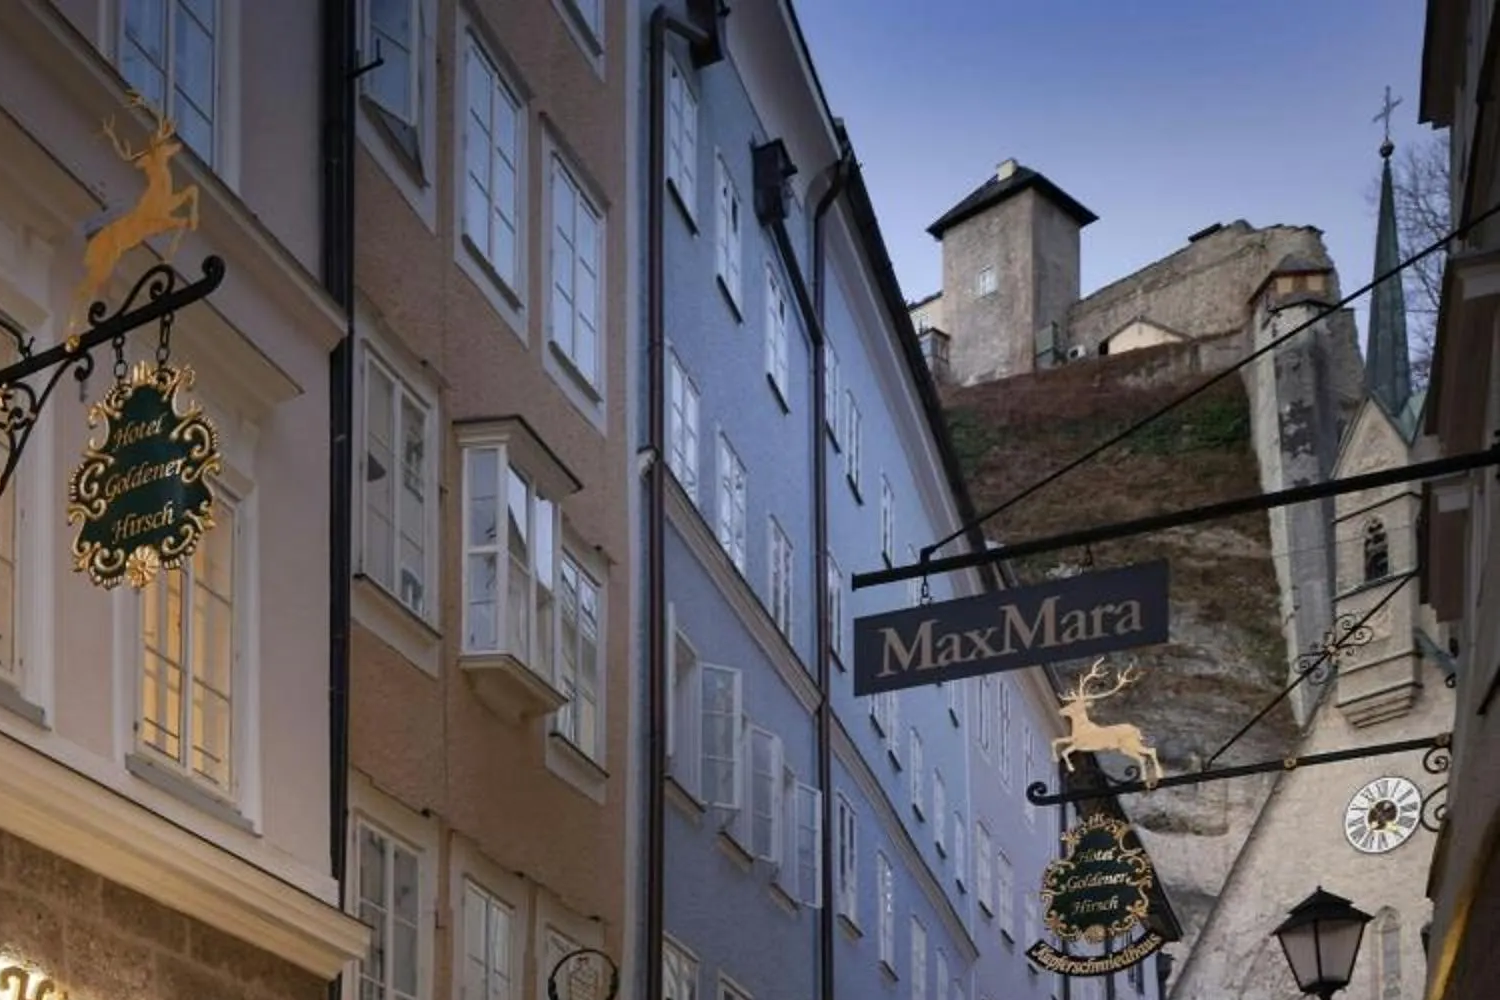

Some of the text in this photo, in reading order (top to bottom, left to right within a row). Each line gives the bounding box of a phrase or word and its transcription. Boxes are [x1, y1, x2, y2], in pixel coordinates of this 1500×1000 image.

[113, 412, 167, 448] Hotel
[105, 456, 186, 501] Goldener
[112, 500, 175, 544] Hirsch
[876, 596, 1144, 678] MaxMara
